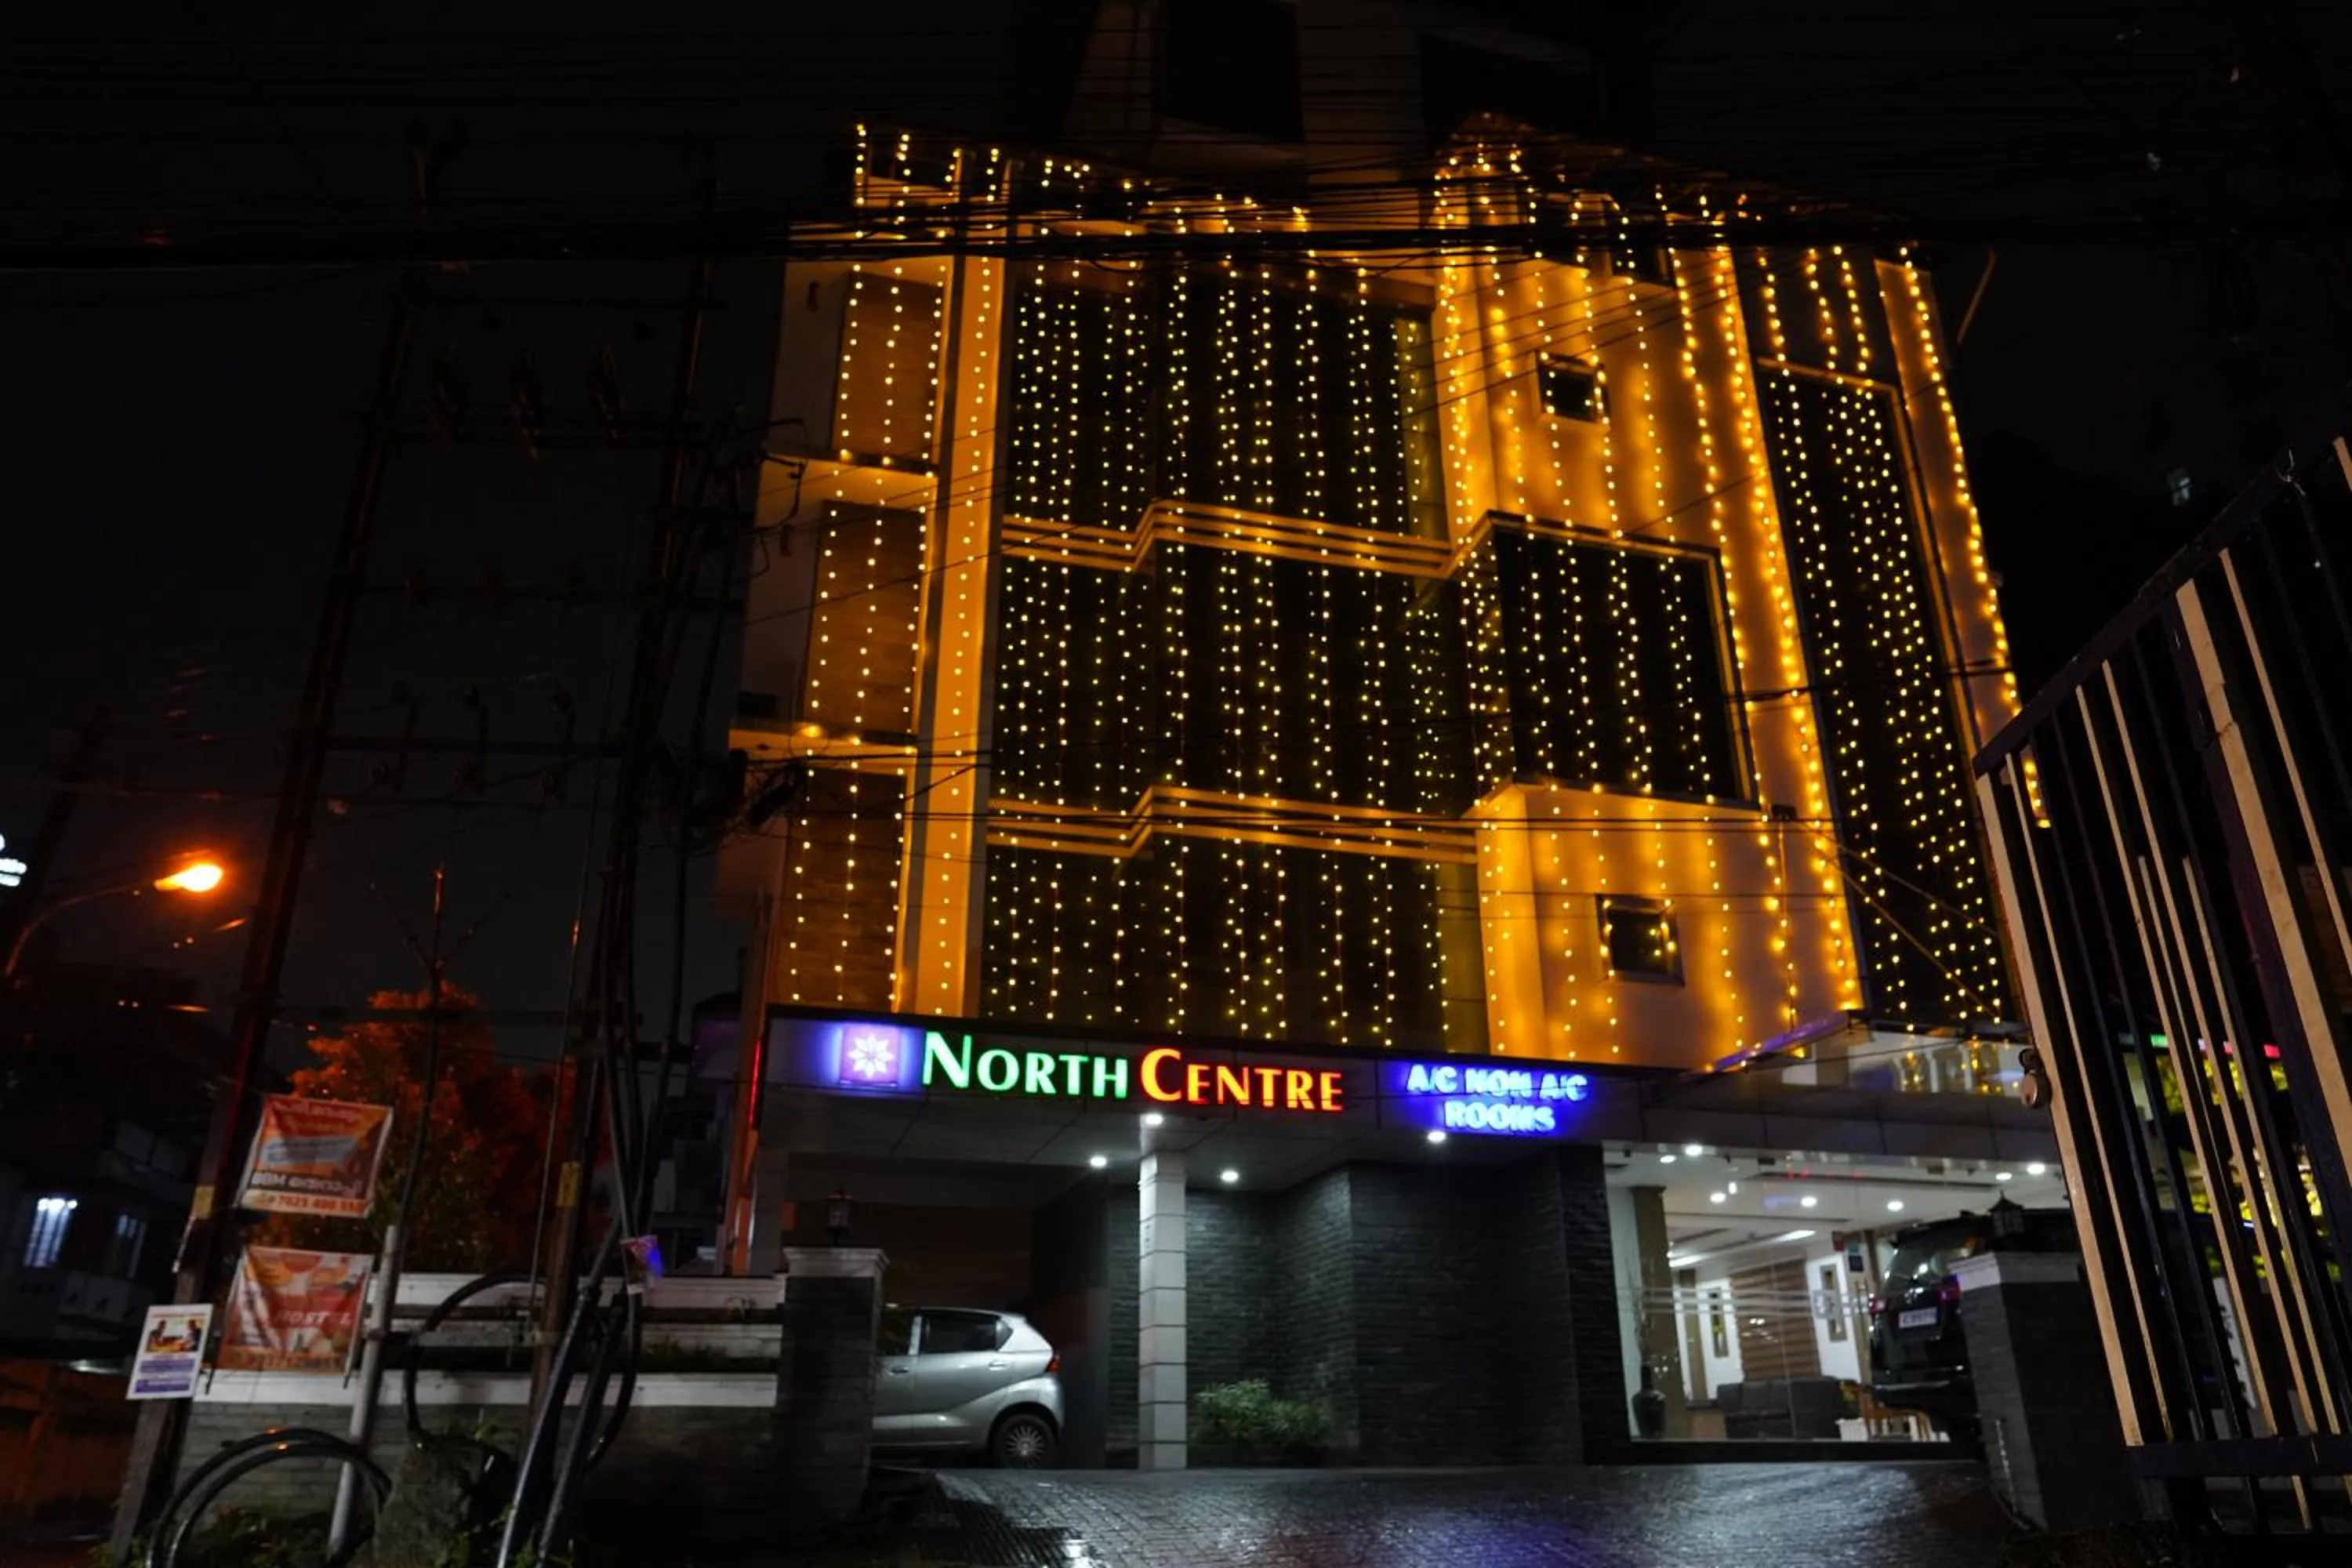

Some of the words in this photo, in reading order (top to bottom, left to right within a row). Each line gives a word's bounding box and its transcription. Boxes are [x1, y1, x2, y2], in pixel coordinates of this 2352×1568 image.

[923, 1031, 1127, 1098] NORTH
[1141, 1048, 1343, 1111] CENTRE
[1406, 1064, 1457, 1093] A/C
[1465, 1068, 1532, 1098] NON
[1540, 1073, 1588, 1102] A/C
[1445, 1100, 1556, 1131] ROOMS
